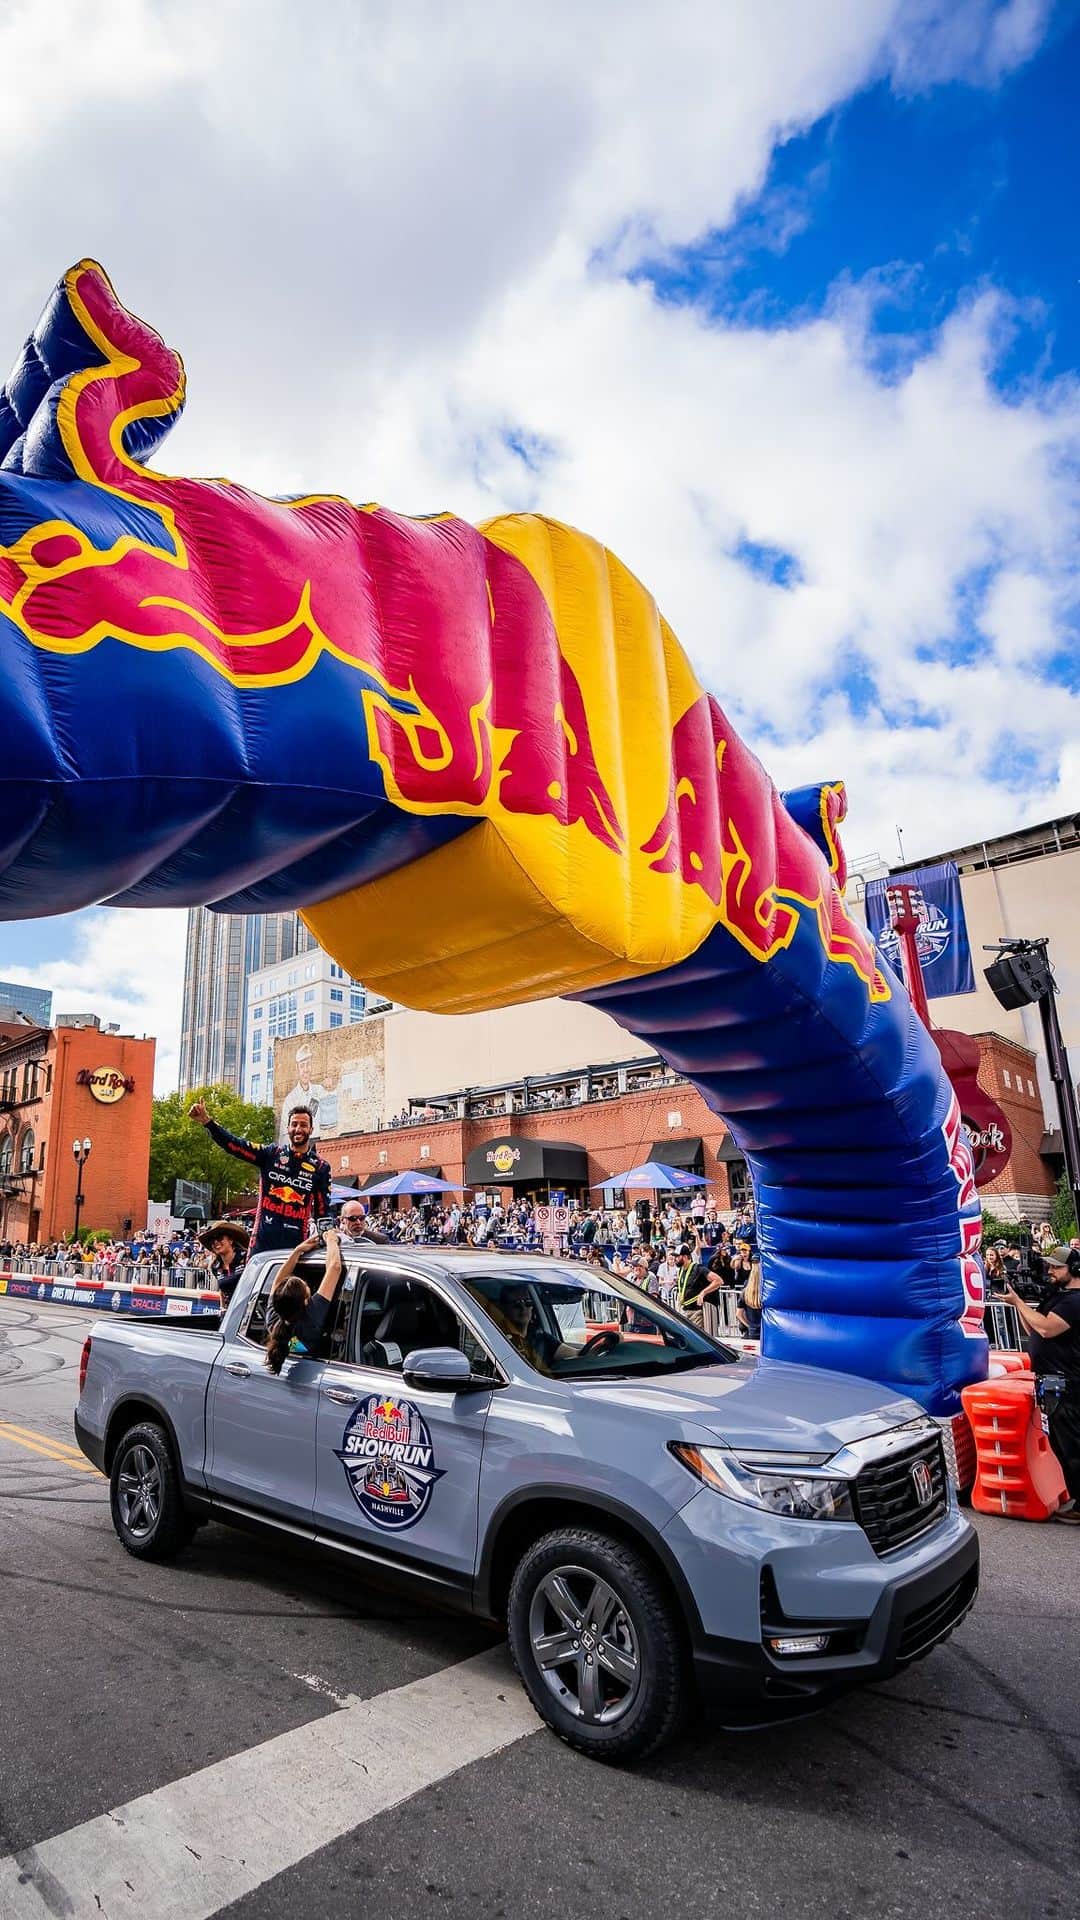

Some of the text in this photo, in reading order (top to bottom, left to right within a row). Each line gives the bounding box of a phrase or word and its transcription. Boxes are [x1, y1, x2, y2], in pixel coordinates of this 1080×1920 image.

[879, 918, 949, 942] SHRUN
[76, 1069, 108, 1086] Hard
[268, 1171, 313, 1191] ORACLE
[262, 1196, 307, 1220] Red Bull
[131, 1298, 161, 1310] ORACLE
[365, 1421, 410, 1444] Red Bull
[345, 1436, 432, 1467] SHOWRUN
[372, 1503, 404, 1516] NASHVILLE
